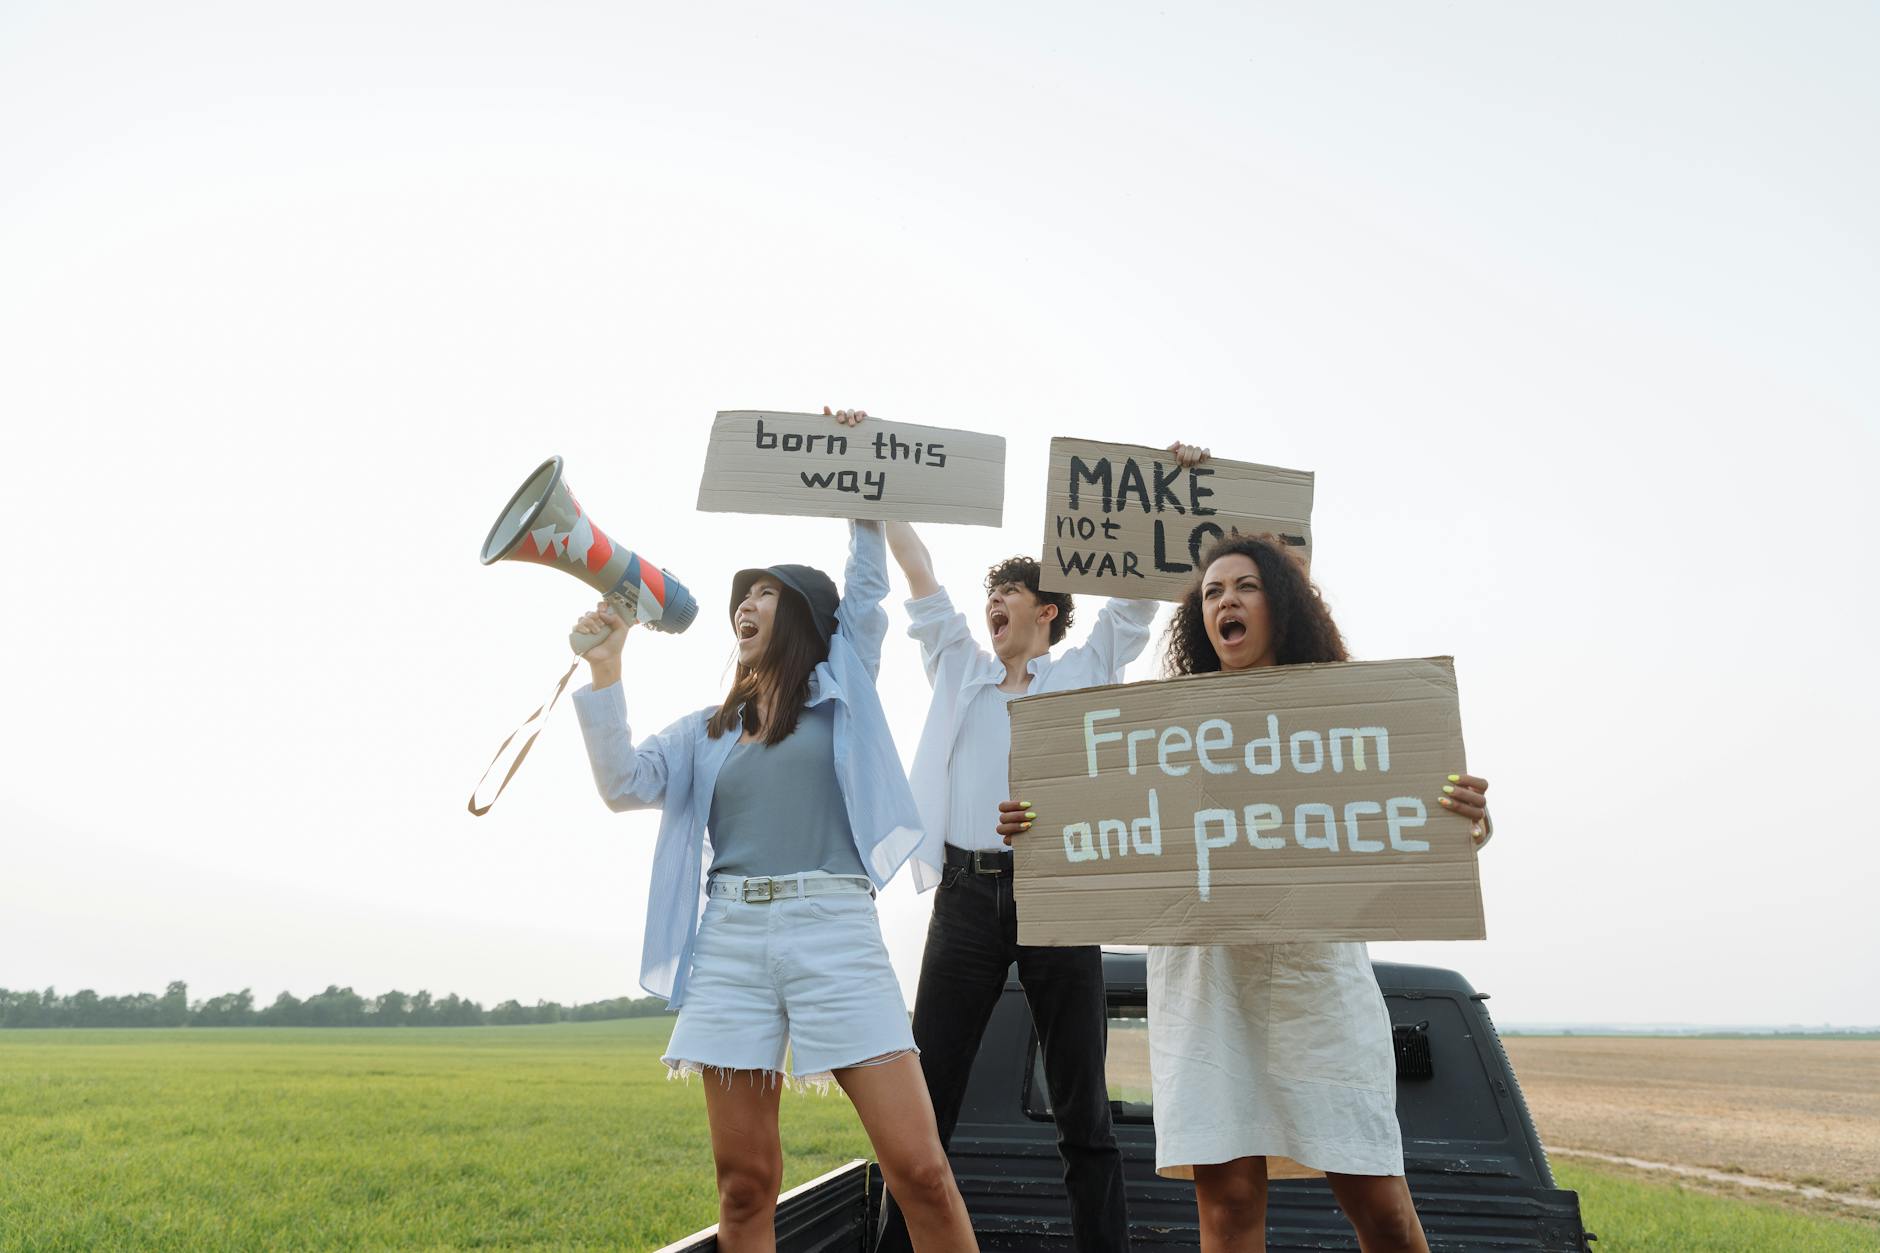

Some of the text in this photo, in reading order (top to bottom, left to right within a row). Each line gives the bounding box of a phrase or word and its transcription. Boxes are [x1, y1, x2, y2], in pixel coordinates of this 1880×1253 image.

[756, 418, 947, 468] born this
[800, 470, 885, 500] way
[1069, 456, 1218, 515] MAKE
[1056, 515, 1121, 540] not
[1154, 519, 1306, 573] LO
[1056, 546, 1145, 579] WAR
[1084, 708, 1390, 778] Freedom
[1062, 788, 1430, 902] and peace
